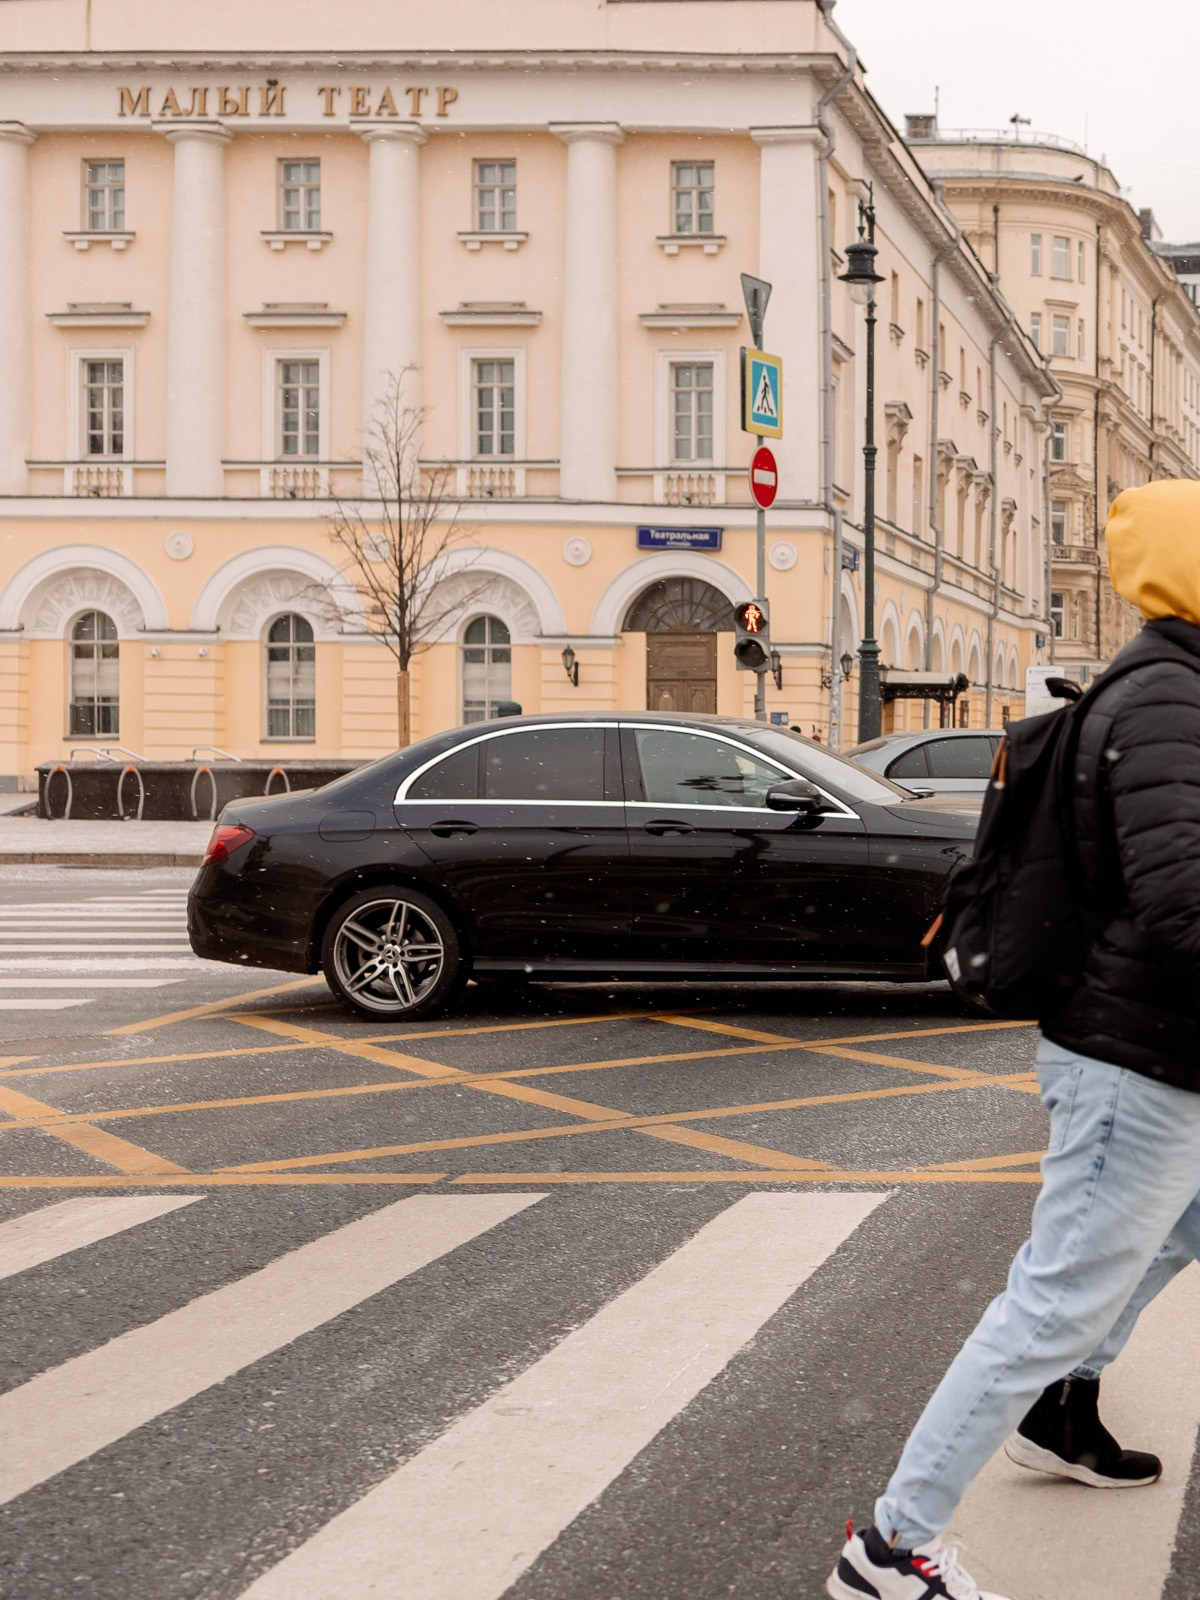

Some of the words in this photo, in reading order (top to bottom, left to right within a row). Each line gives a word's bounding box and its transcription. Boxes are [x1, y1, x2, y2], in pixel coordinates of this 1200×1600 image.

[117, 79, 287, 117] МАЛЫЙ
[318, 86, 459, 117] ТЕАТР
[650, 529, 710, 541] Театральная
